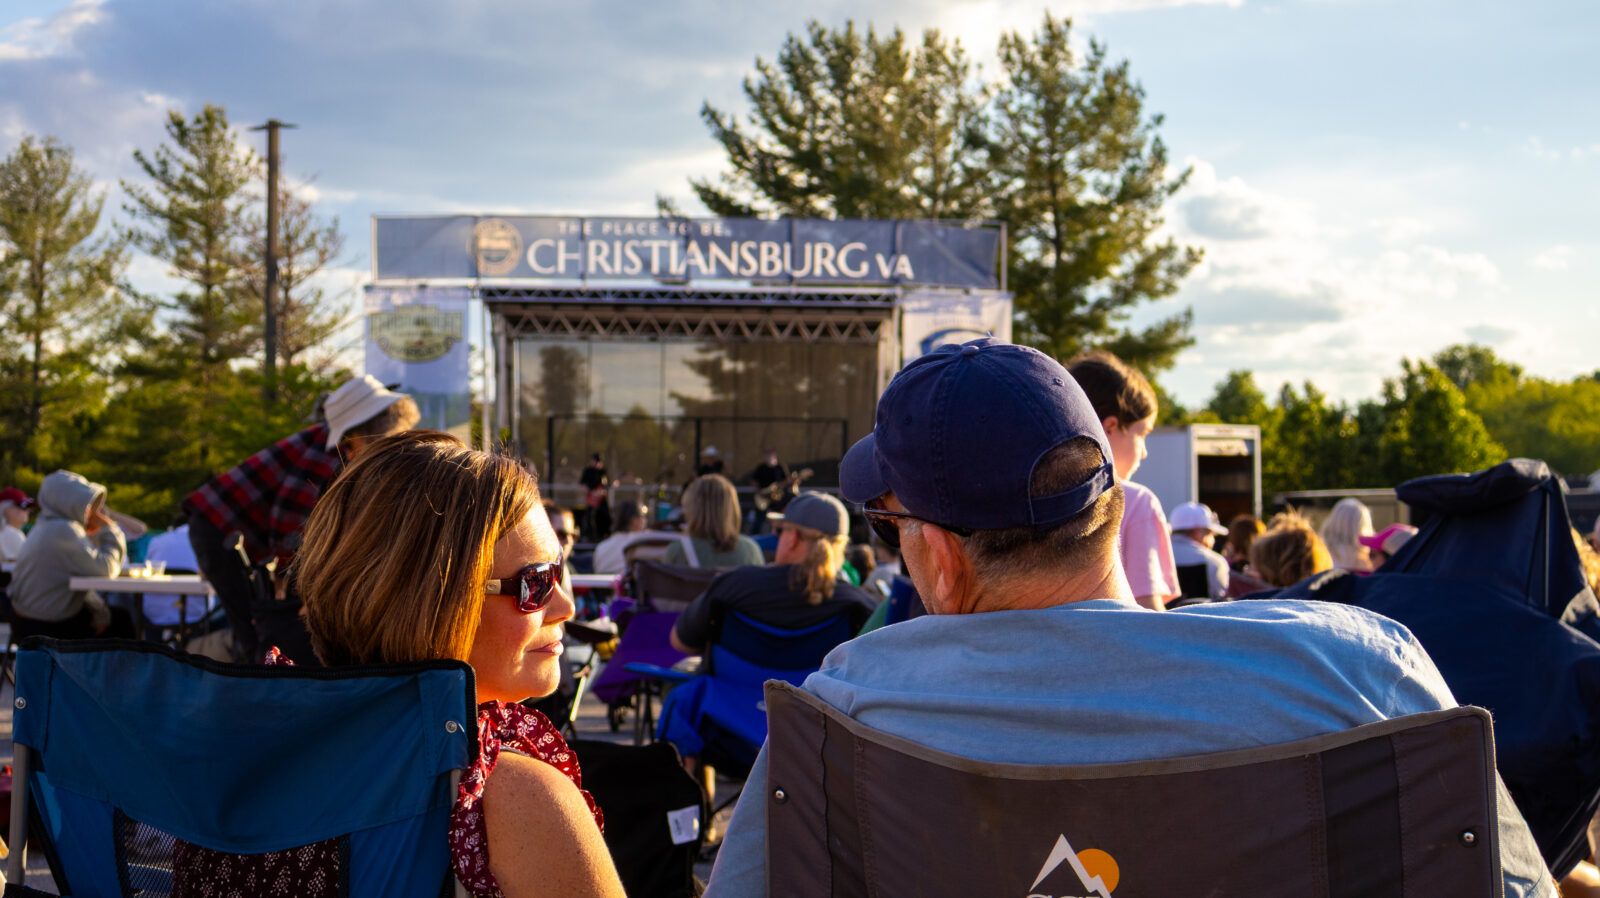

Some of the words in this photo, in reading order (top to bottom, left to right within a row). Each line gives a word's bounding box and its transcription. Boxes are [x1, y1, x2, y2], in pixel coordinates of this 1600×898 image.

[559, 222, 592, 235] THE
[602, 222, 658, 235] PLACE
[669, 222, 691, 235] TO
[526, 239, 870, 279] CHRISTIANSBURG
[875, 253, 915, 280] VA
